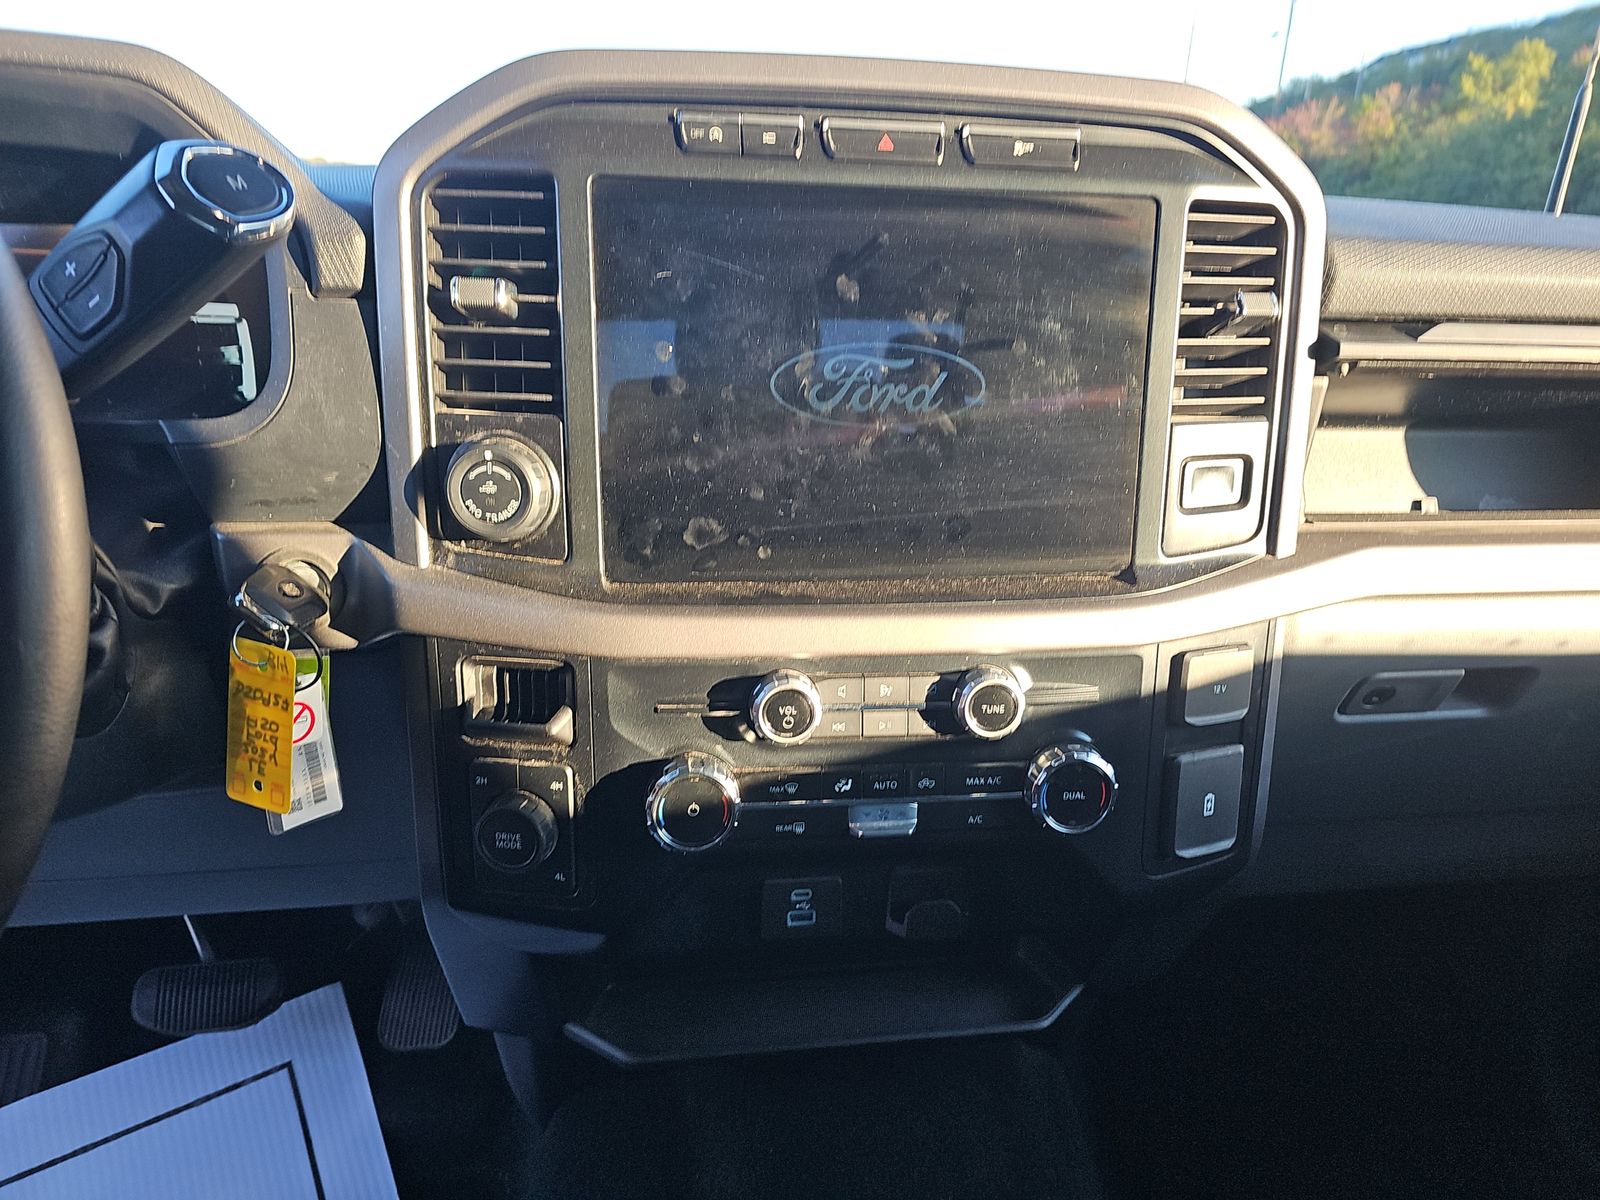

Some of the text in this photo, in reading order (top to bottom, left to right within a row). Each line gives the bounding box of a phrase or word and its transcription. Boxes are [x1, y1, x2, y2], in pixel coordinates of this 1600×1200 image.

[226, 174, 248, 192] M
[808, 353, 949, 414] Ford
[465, 498, 482, 519] PRO
[779, 705, 797, 716] VOL
[981, 704, 1005, 715] TUNE
[475, 776, 488, 786] 2H
[550, 780, 564, 792] 4H
[873, 780, 898, 790] AUTO
[965, 776, 1002, 786] MAX A/C
[1063, 791, 1086, 801] DUAL
[967, 814, 984, 825] A/C
[495, 831, 521, 841] DRIVE
[495, 840, 522, 850] MODE
